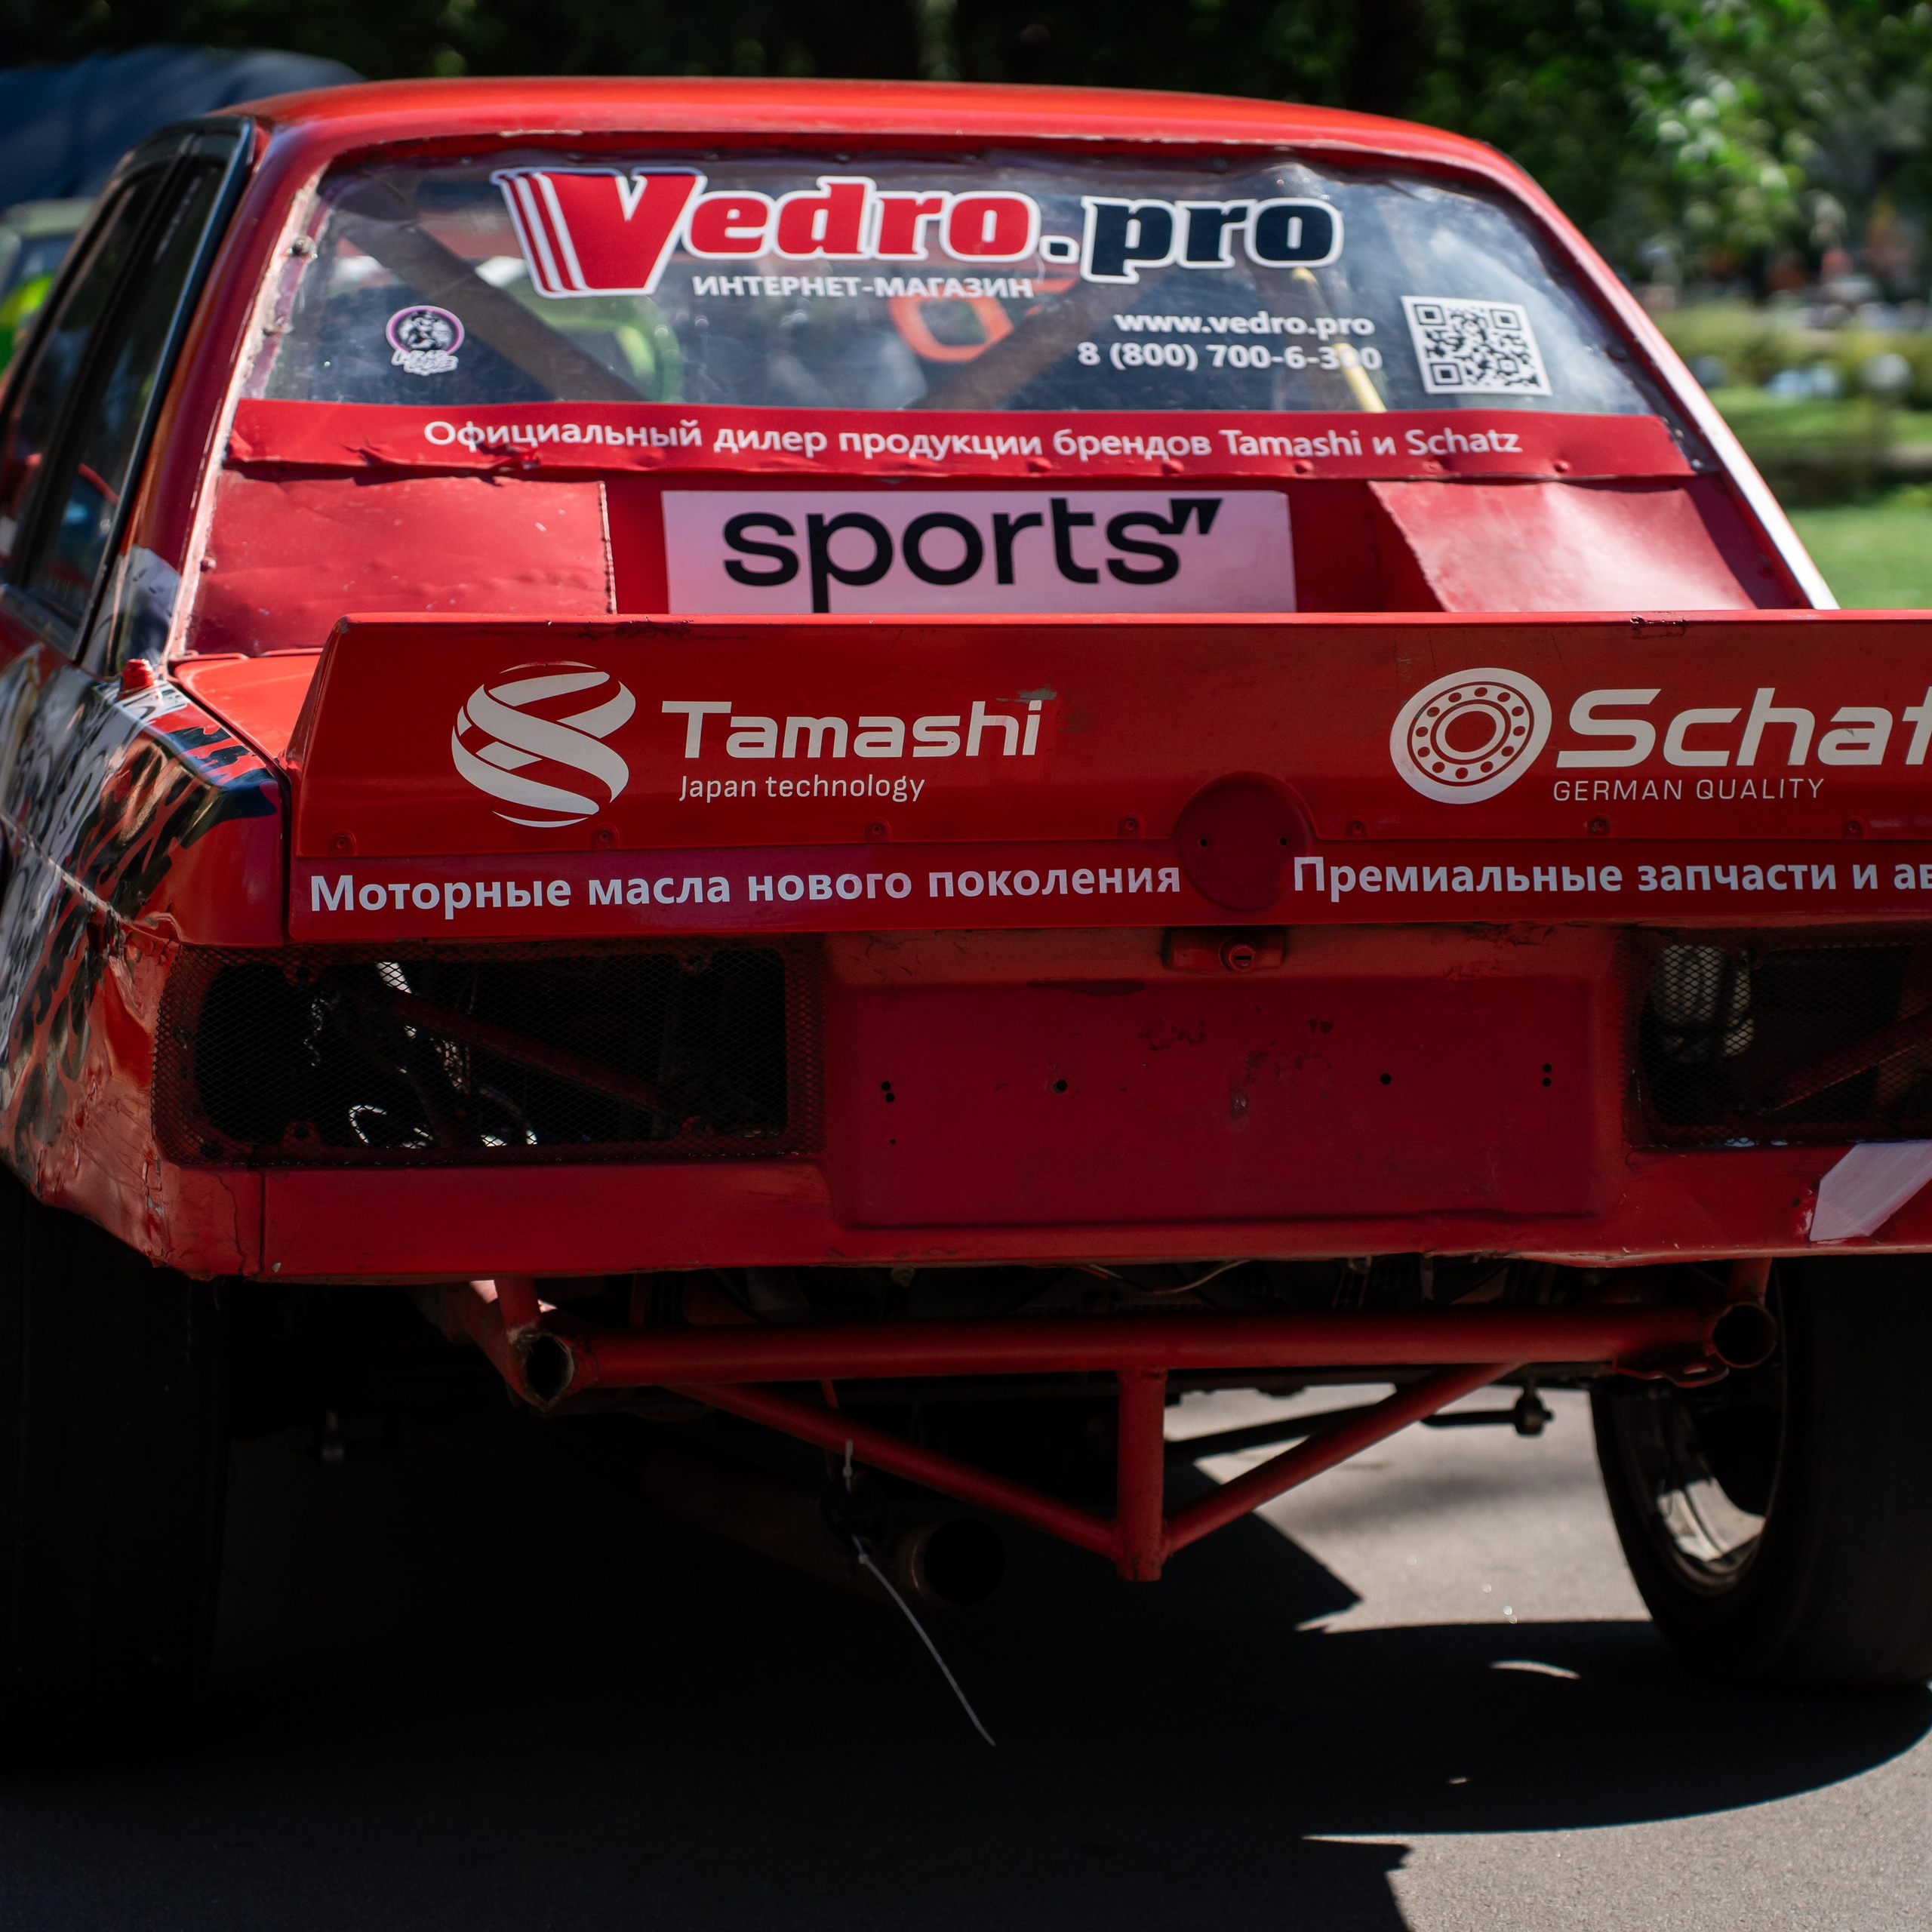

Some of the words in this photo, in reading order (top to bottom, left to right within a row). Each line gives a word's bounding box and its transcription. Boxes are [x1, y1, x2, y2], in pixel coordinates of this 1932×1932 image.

[491, 168, 1344, 299] Vedro.pro
[691, 274, 1035, 299] ИНТЕРНЕТ-МАГАЗИН
[1113, 310, 1377, 341] www.vedro.pro
[1076, 341, 1101, 366] 8
[1109, 342, 1199, 371] (800)
[1205, 343, 1383, 370] 700-6-300
[423, 419, 703, 454] Официальный
[712, 428, 829, 459] дилер
[838, 432, 1043, 463] продукции
[1052, 428, 1212, 460] брендов
[1219, 429, 1363, 457] Tamashi
[1371, 435, 1398, 456] и
[1405, 426, 1524, 456] Schatz
[661, 699, 1043, 759] Tamashi
[678, 774, 757, 804] Japan
[764, 774, 926, 803] technology
[1552, 779, 1683, 802] GERMAN
[1695, 777, 1825, 801] QUALITY
[310, 874, 572, 921] Моторные
[588, 875, 731, 906] масла
[747, 872, 912, 903] нового
[928, 866, 1181, 898] поколения
[1293, 856, 1623, 903] Премиальные
[1637, 863, 1837, 891] запчасти
[1852, 863, 1879, 890] и
